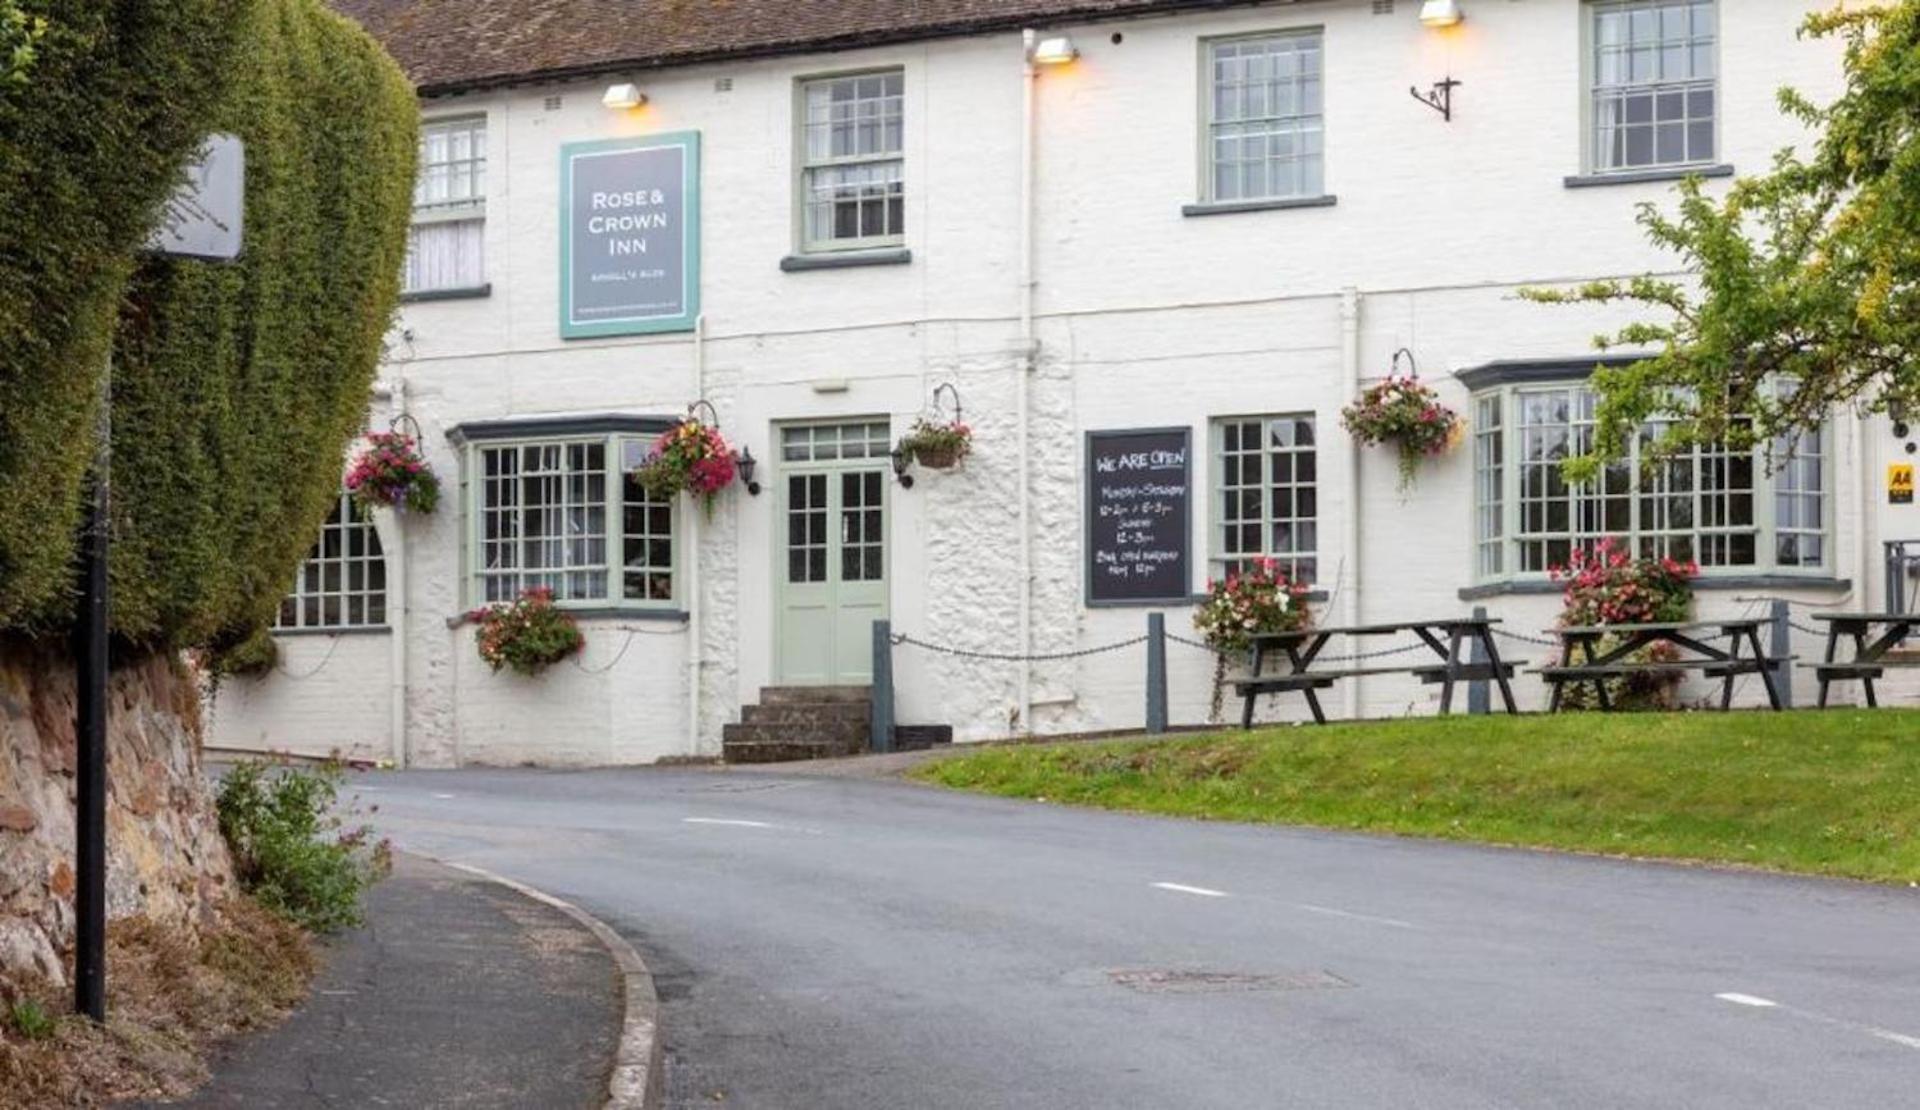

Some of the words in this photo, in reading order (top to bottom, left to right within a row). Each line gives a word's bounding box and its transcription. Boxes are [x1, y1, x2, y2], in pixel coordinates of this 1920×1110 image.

[592, 190, 648, 209] ROSE
[650, 189, 664, 205] &
[589, 212, 667, 234] CROWN
[609, 238, 647, 256] INN
[1096, 457, 1116, 472] WE
[1119, 453, 1149, 469] ARE
[1150, 449, 1186, 465] OPEN
[1892, 471, 1911, 485] AA
